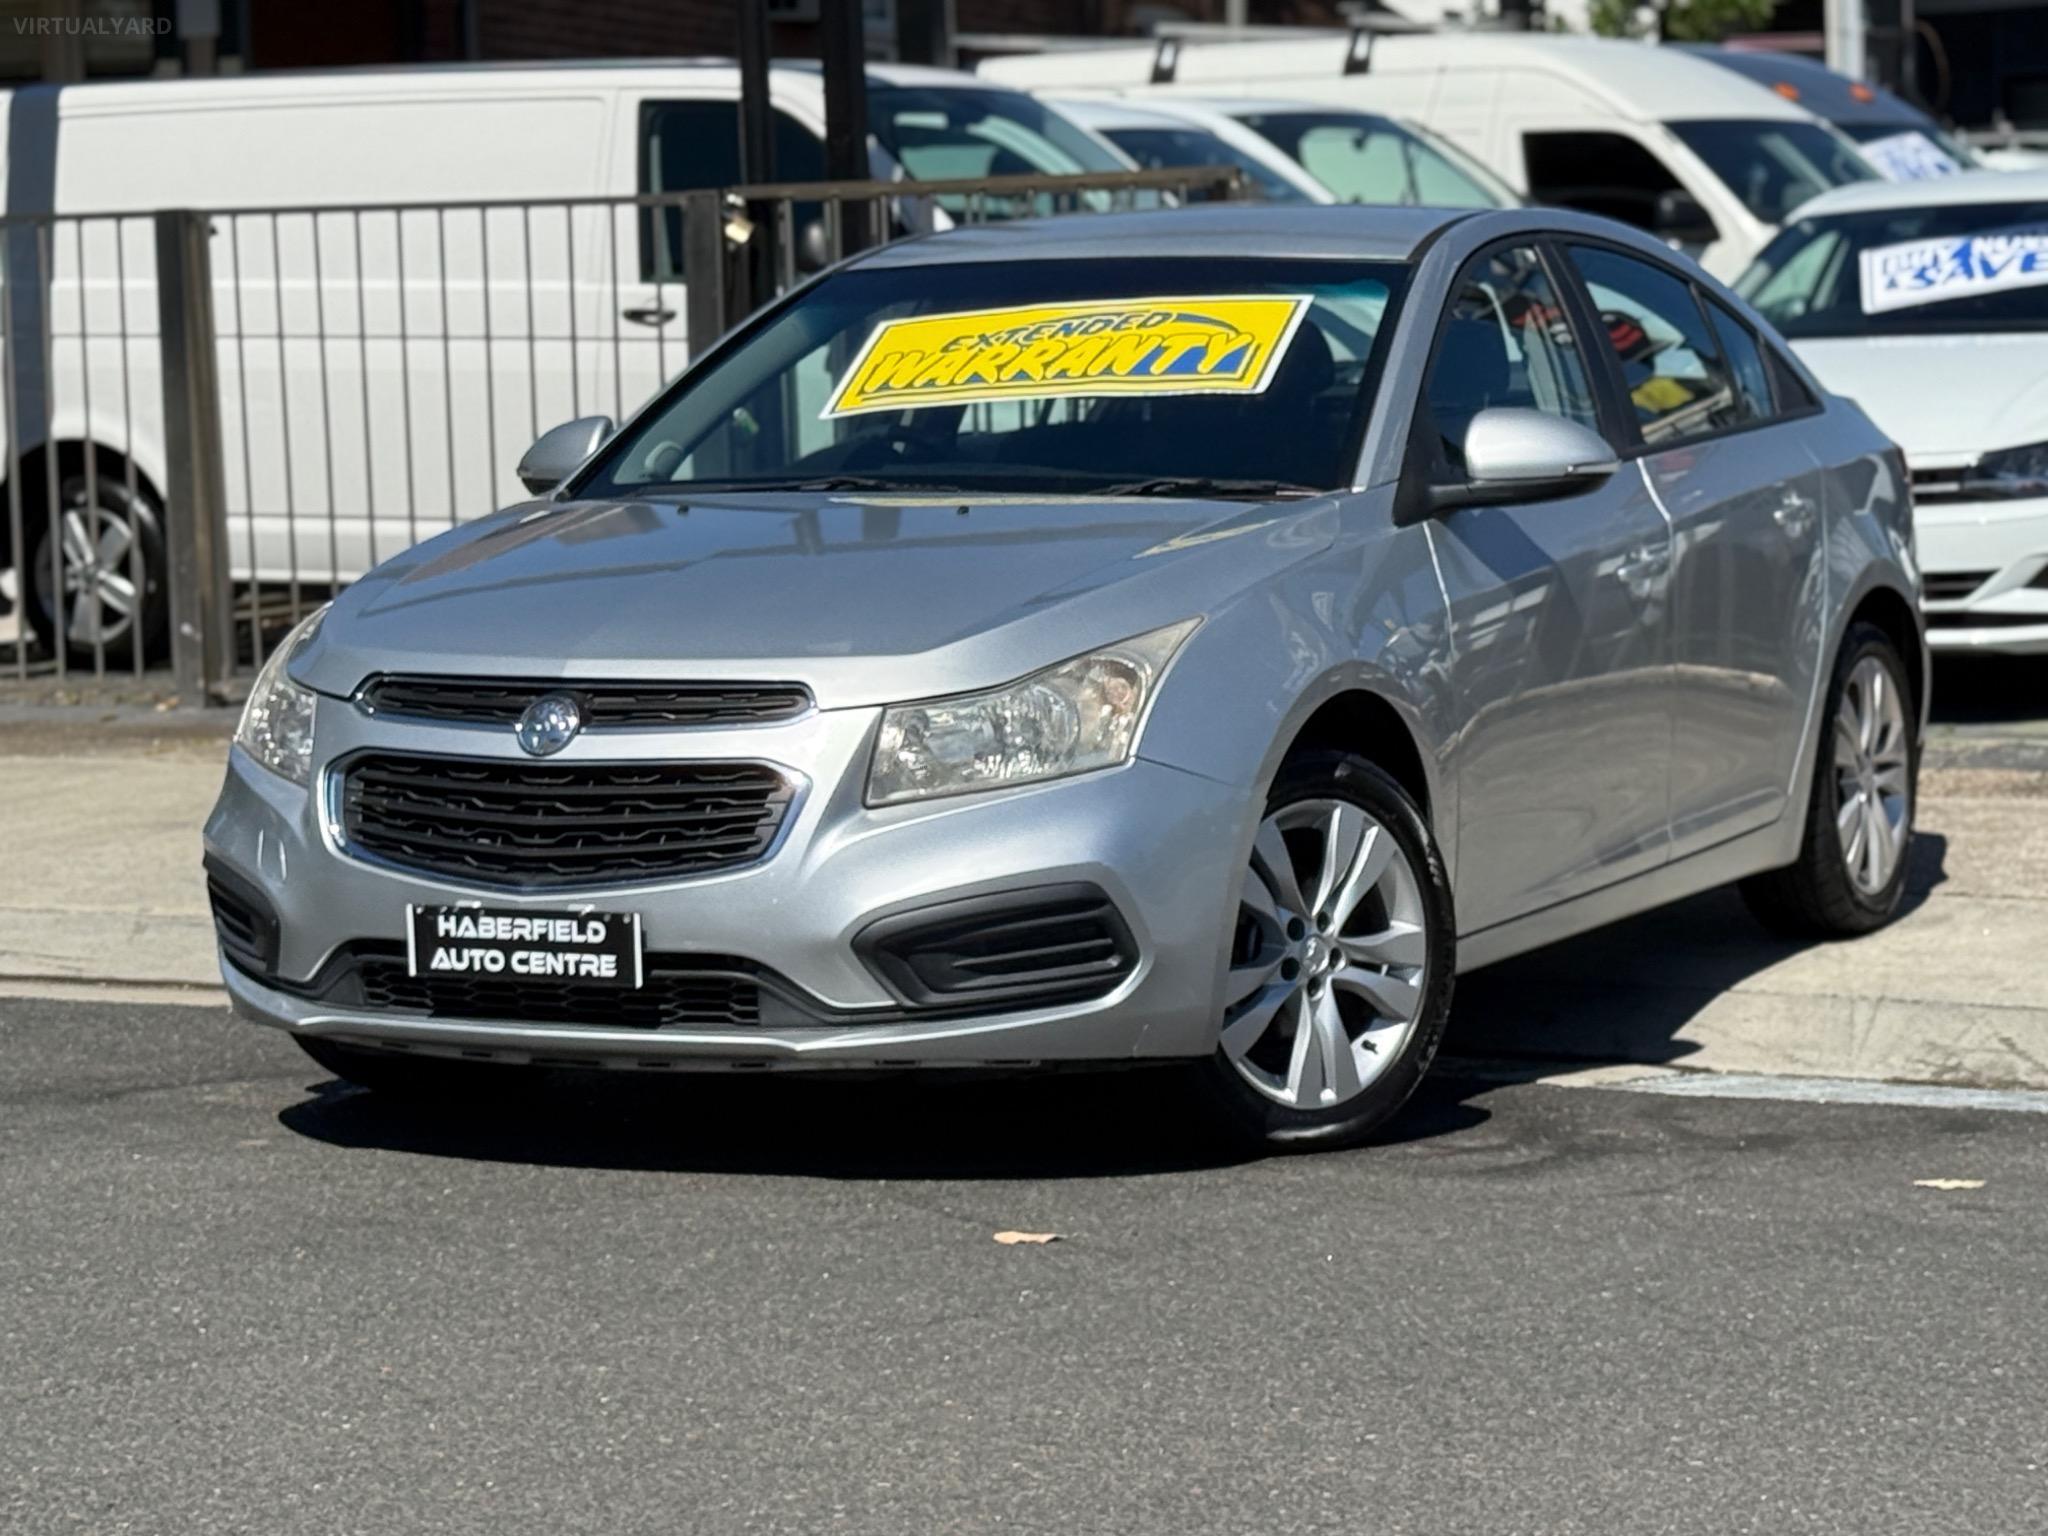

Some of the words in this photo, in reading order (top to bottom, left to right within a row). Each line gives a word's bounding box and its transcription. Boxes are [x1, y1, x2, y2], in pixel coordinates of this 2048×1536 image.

[941, 310, 1175, 353] EXTENDED
[863, 332, 1255, 392] WARRANTY
[437, 914, 607, 945] HABERFIELD
[430, 947, 505, 973] AUTO
[510, 950, 618, 978] CENTRE
